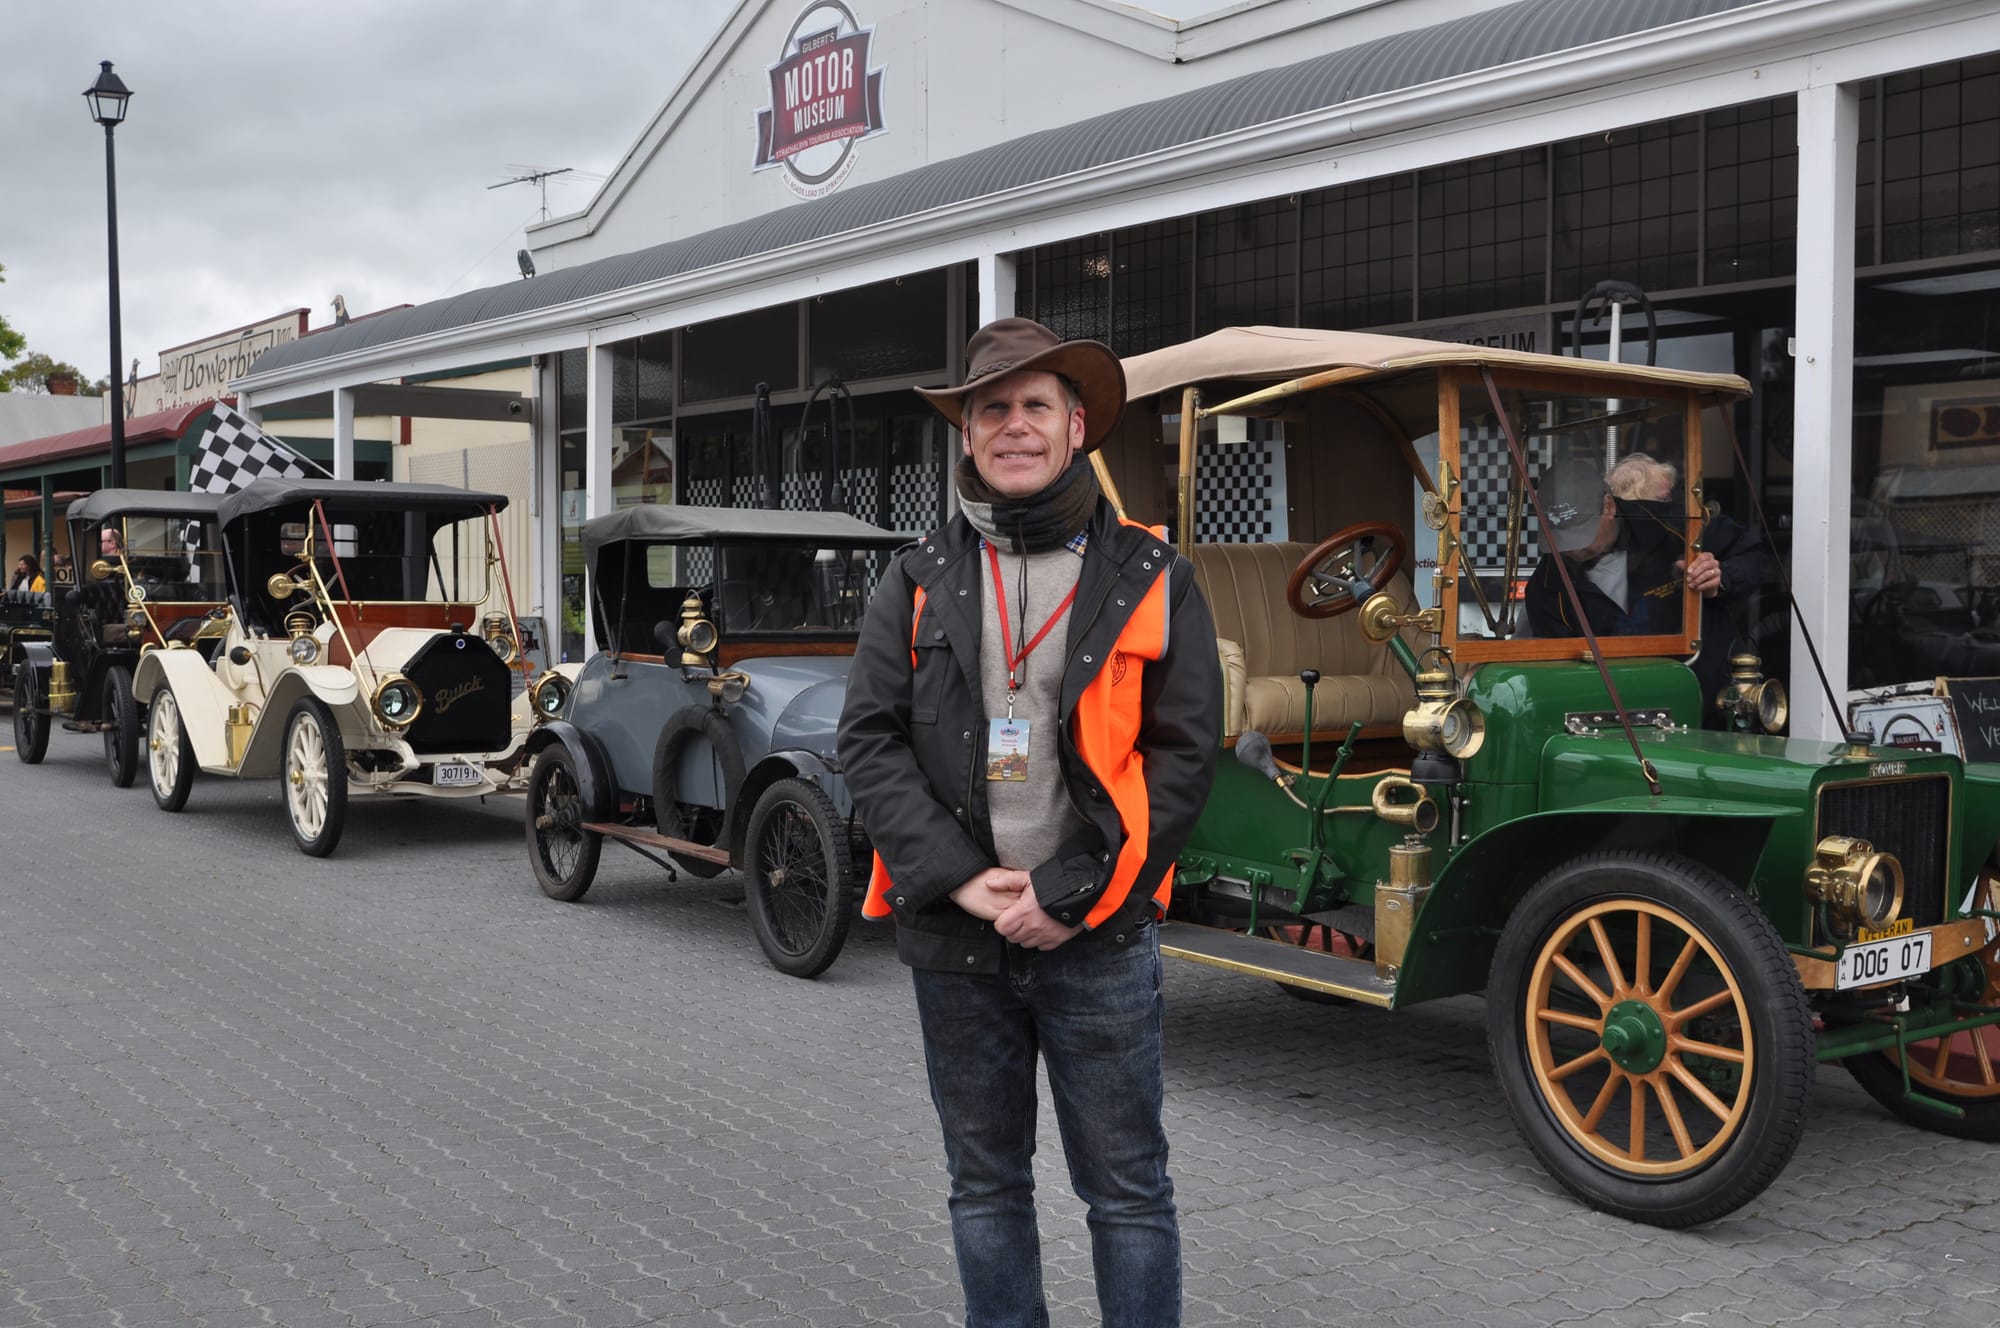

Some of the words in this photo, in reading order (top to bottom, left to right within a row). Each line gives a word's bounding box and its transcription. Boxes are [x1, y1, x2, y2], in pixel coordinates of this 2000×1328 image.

[802, 32, 835, 54] GILBERT'S
[784, 47, 854, 111] MOTOR
[793, 94, 845, 135] MUSEUM
[808, 133, 831, 146] TOURISM
[831, 125, 865, 138] ASSOCIATION
[805, 189, 818, 197] LEAD
[435, 675, 484, 714] Buick
[1853, 947, 1888, 981] DOG
[1901, 940, 1924, 971] 07
